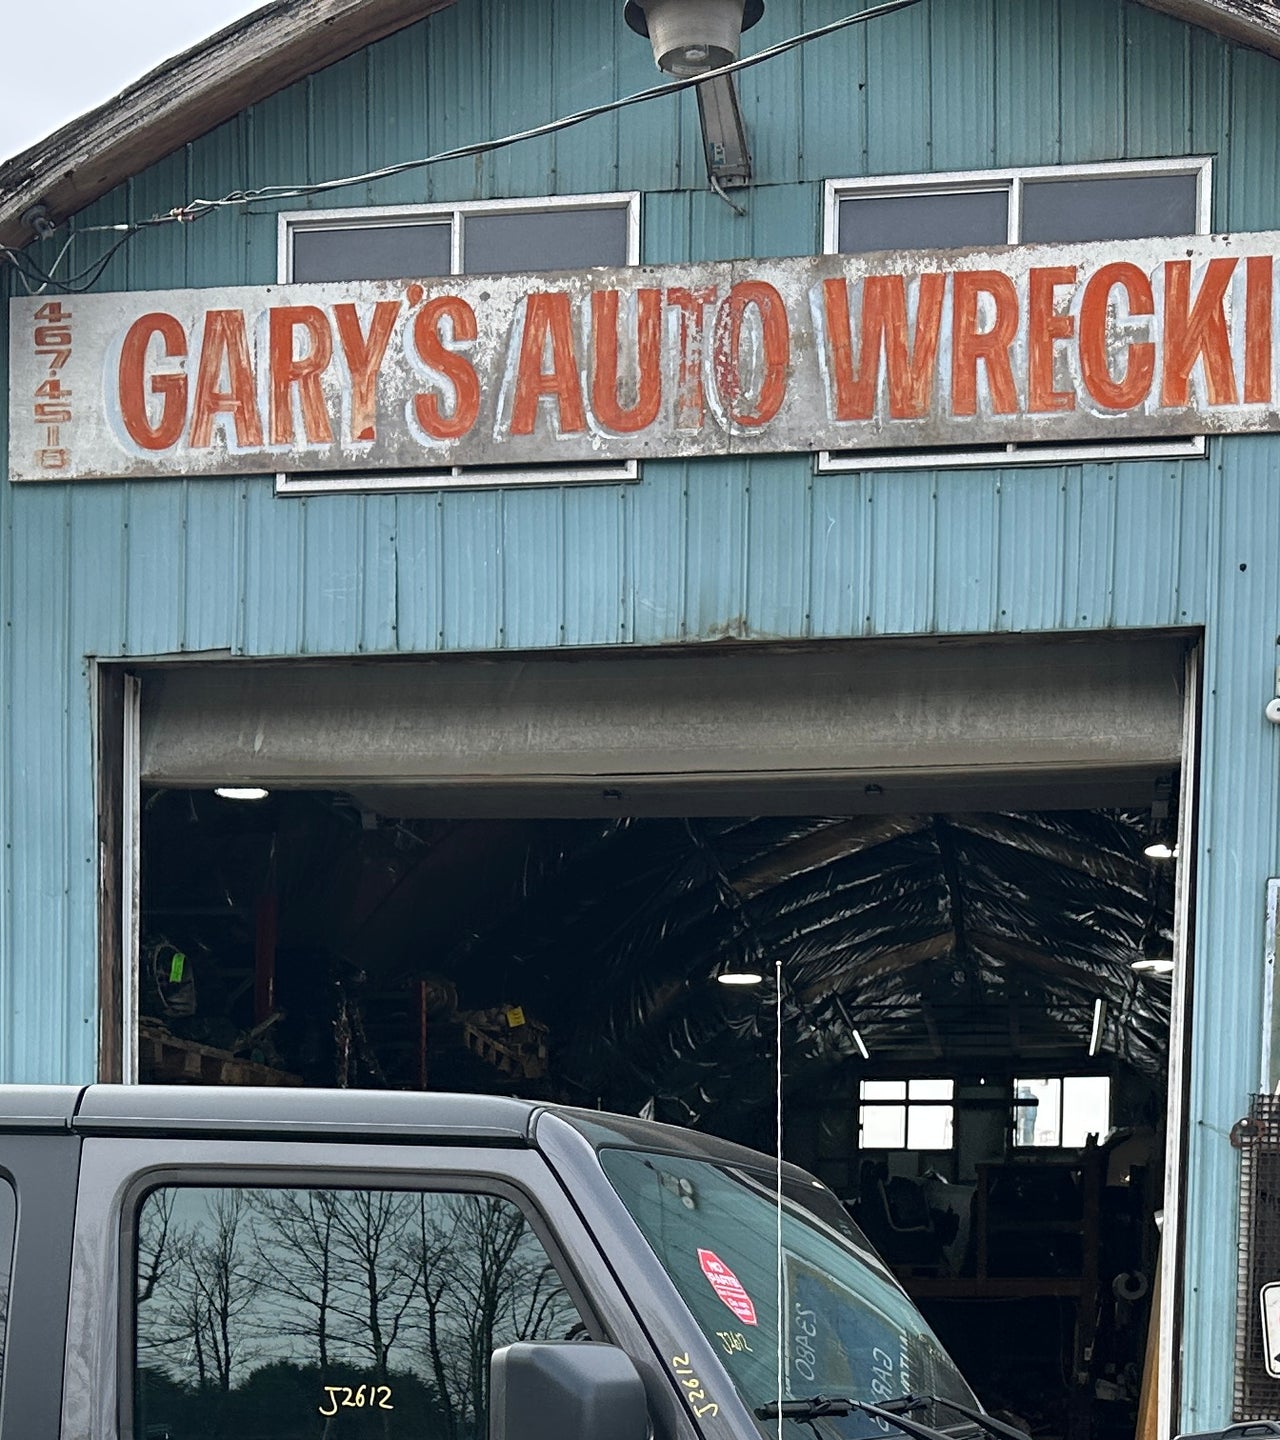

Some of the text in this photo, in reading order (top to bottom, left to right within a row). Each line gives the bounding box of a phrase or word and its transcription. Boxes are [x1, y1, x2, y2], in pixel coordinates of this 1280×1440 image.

[119, 283, 479, 450] GARY'S
[510, 280, 790, 436] AUTO
[319, 1385, 394, 1416] J2612
[673, 1353, 718, 1419] J2612
